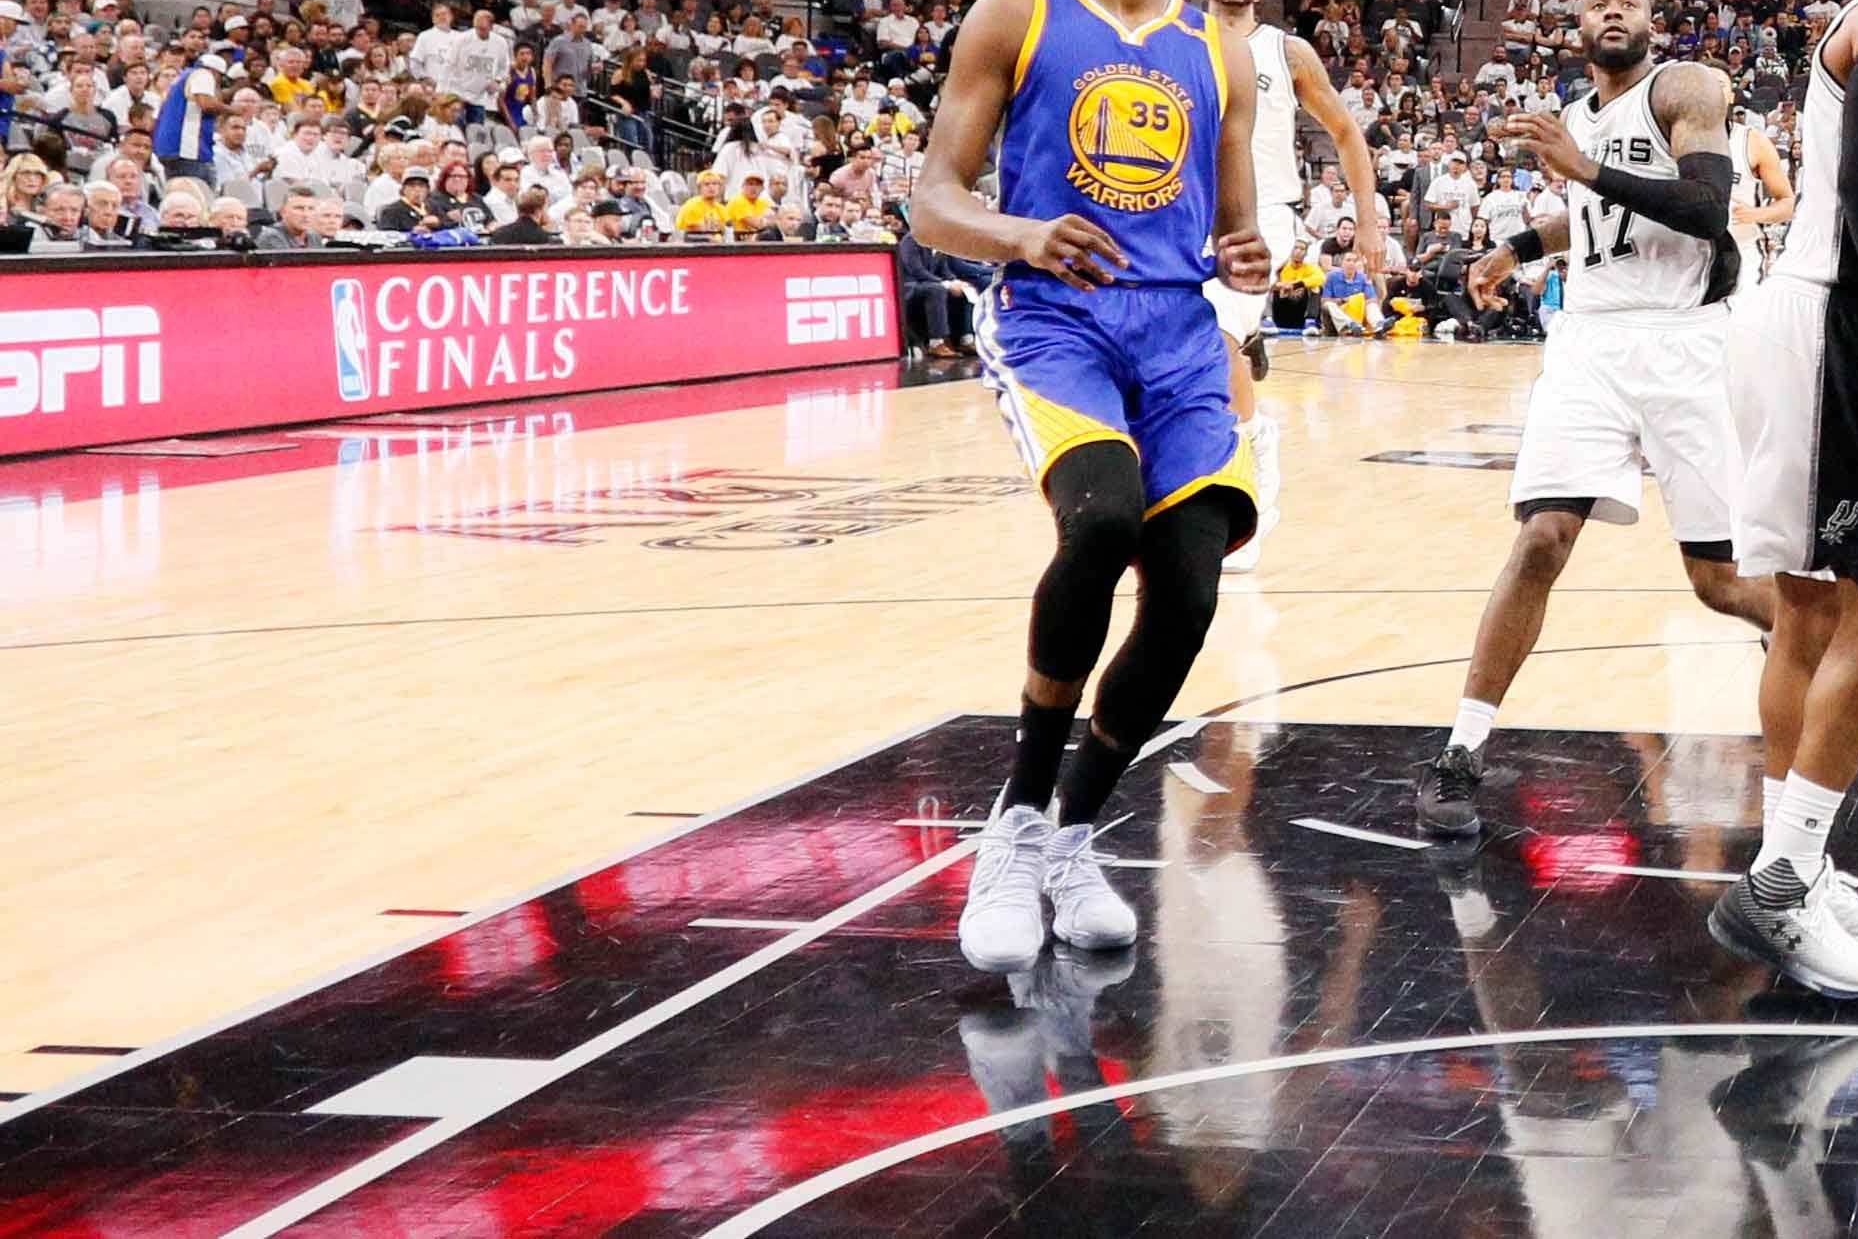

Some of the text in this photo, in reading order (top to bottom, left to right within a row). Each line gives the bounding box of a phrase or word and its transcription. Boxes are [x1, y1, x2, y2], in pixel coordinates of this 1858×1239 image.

[1073, 63, 1195, 112] GOLDEN STATE
[1128, 101, 1169, 131] 35
[1066, 162, 1184, 211] WARRIORS
[1581, 199, 1636, 268] 17
[376, 269, 690, 333] CONFERENCE
[785, 275, 885, 345] ESPN
[0, 305, 160, 418] SPN
[378, 328, 577, 397] FINALS
